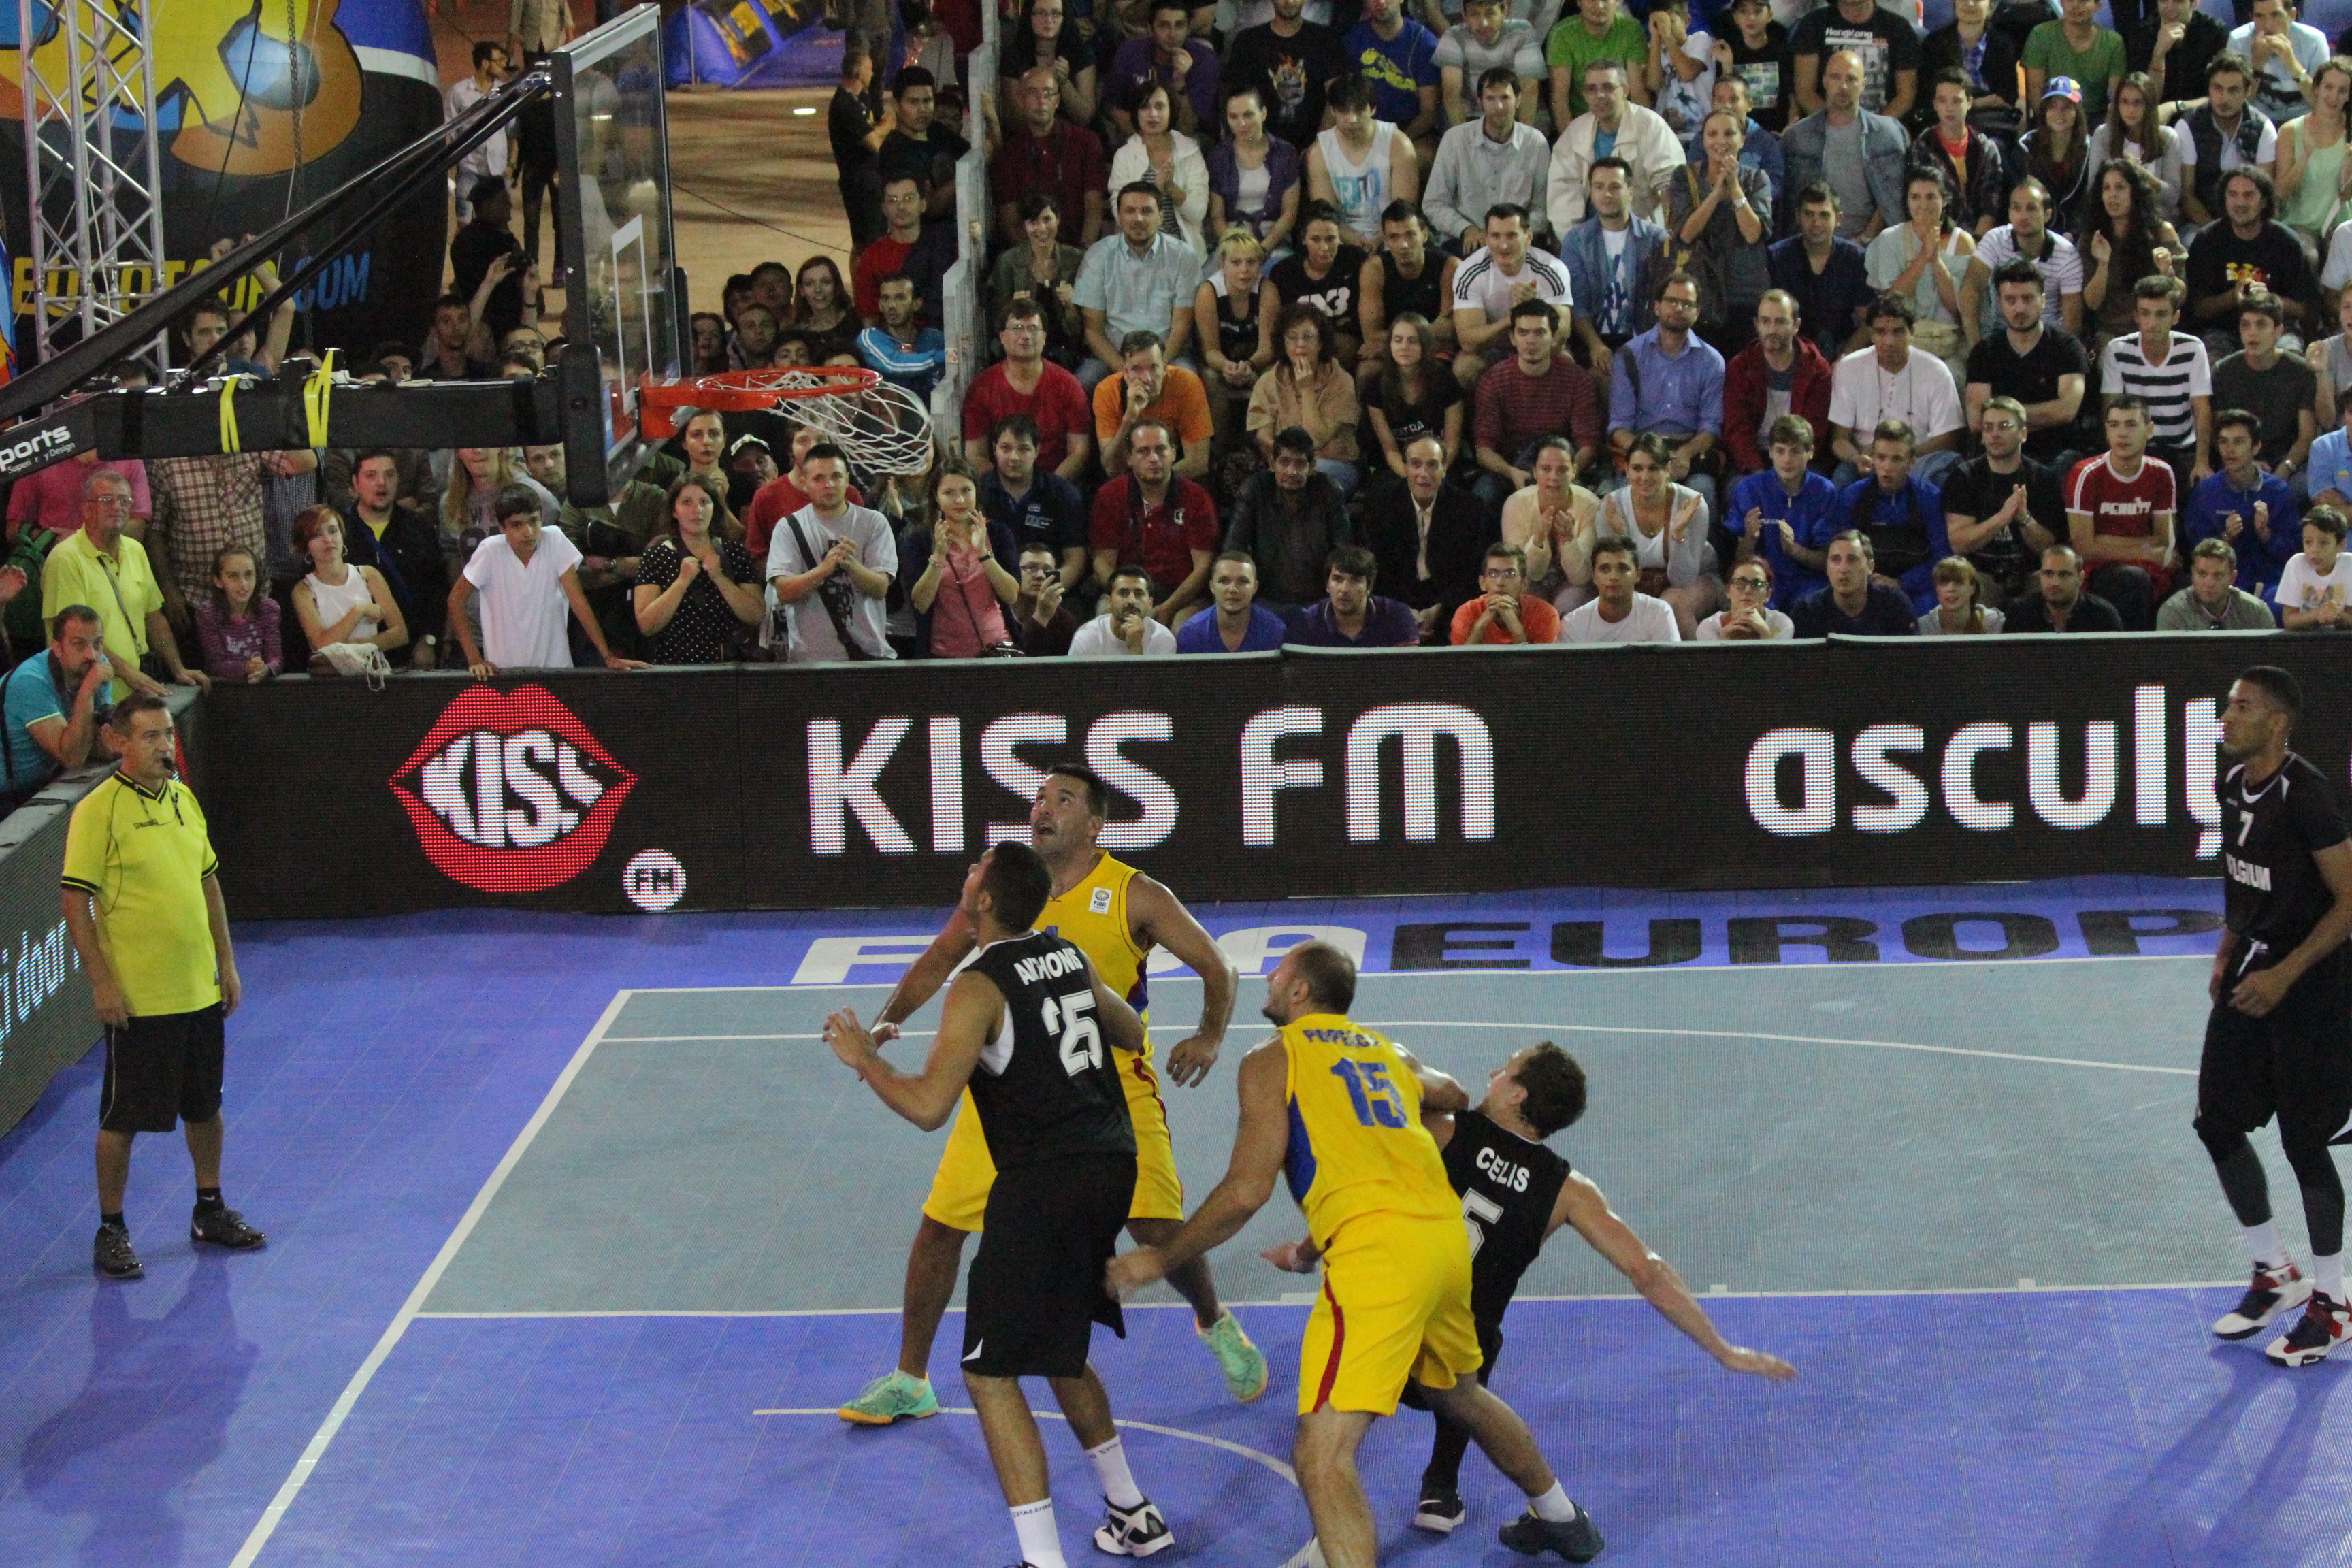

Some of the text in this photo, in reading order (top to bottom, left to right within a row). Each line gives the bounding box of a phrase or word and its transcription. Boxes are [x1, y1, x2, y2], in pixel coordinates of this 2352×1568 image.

[421, 730, 604, 847] KISS
[807, 702, 1494, 855] KISS FM
[2237, 810, 2255, 847] 7
[635, 868, 673, 892] FM
[1390, 908, 2225, 971] EUROP
[1041, 988, 1103, 1077] 25
[1330, 1056, 1409, 1129] 15
[1475, 1146, 1531, 1193] CELIS
